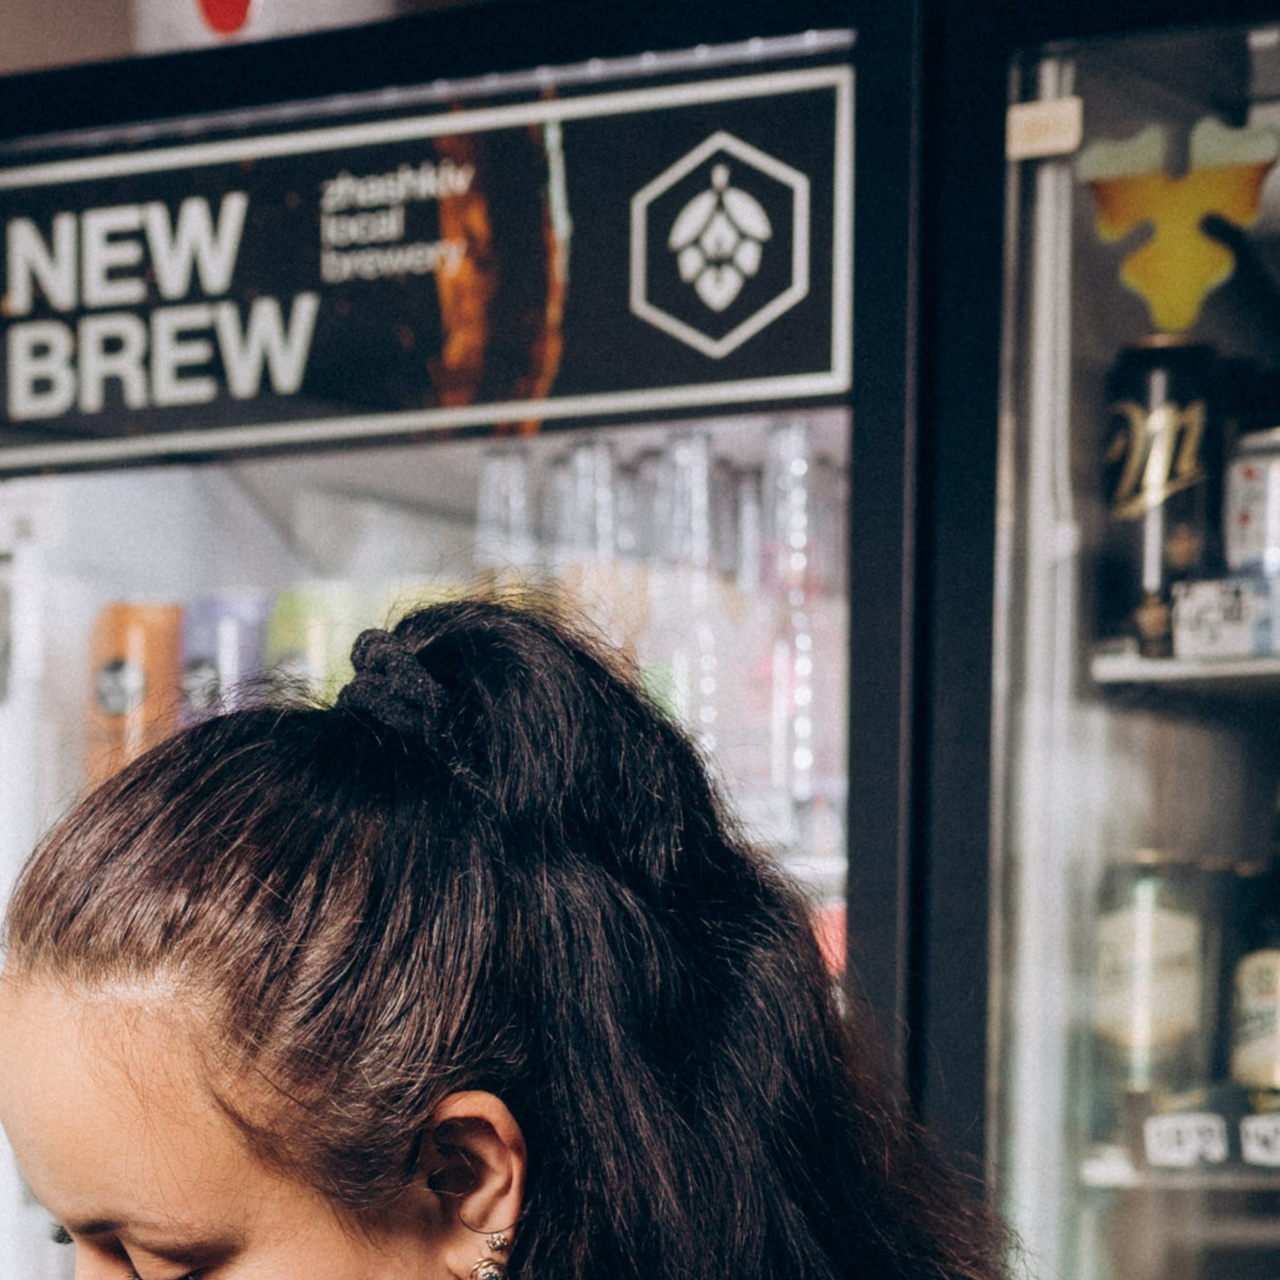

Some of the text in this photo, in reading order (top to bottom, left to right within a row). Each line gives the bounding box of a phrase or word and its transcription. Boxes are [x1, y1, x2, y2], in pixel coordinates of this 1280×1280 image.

[5, 191, 249, 317] NEW
[321, 204, 405, 247] local
[321, 237, 466, 283] brewery
[6, 291, 321, 422] BREW
